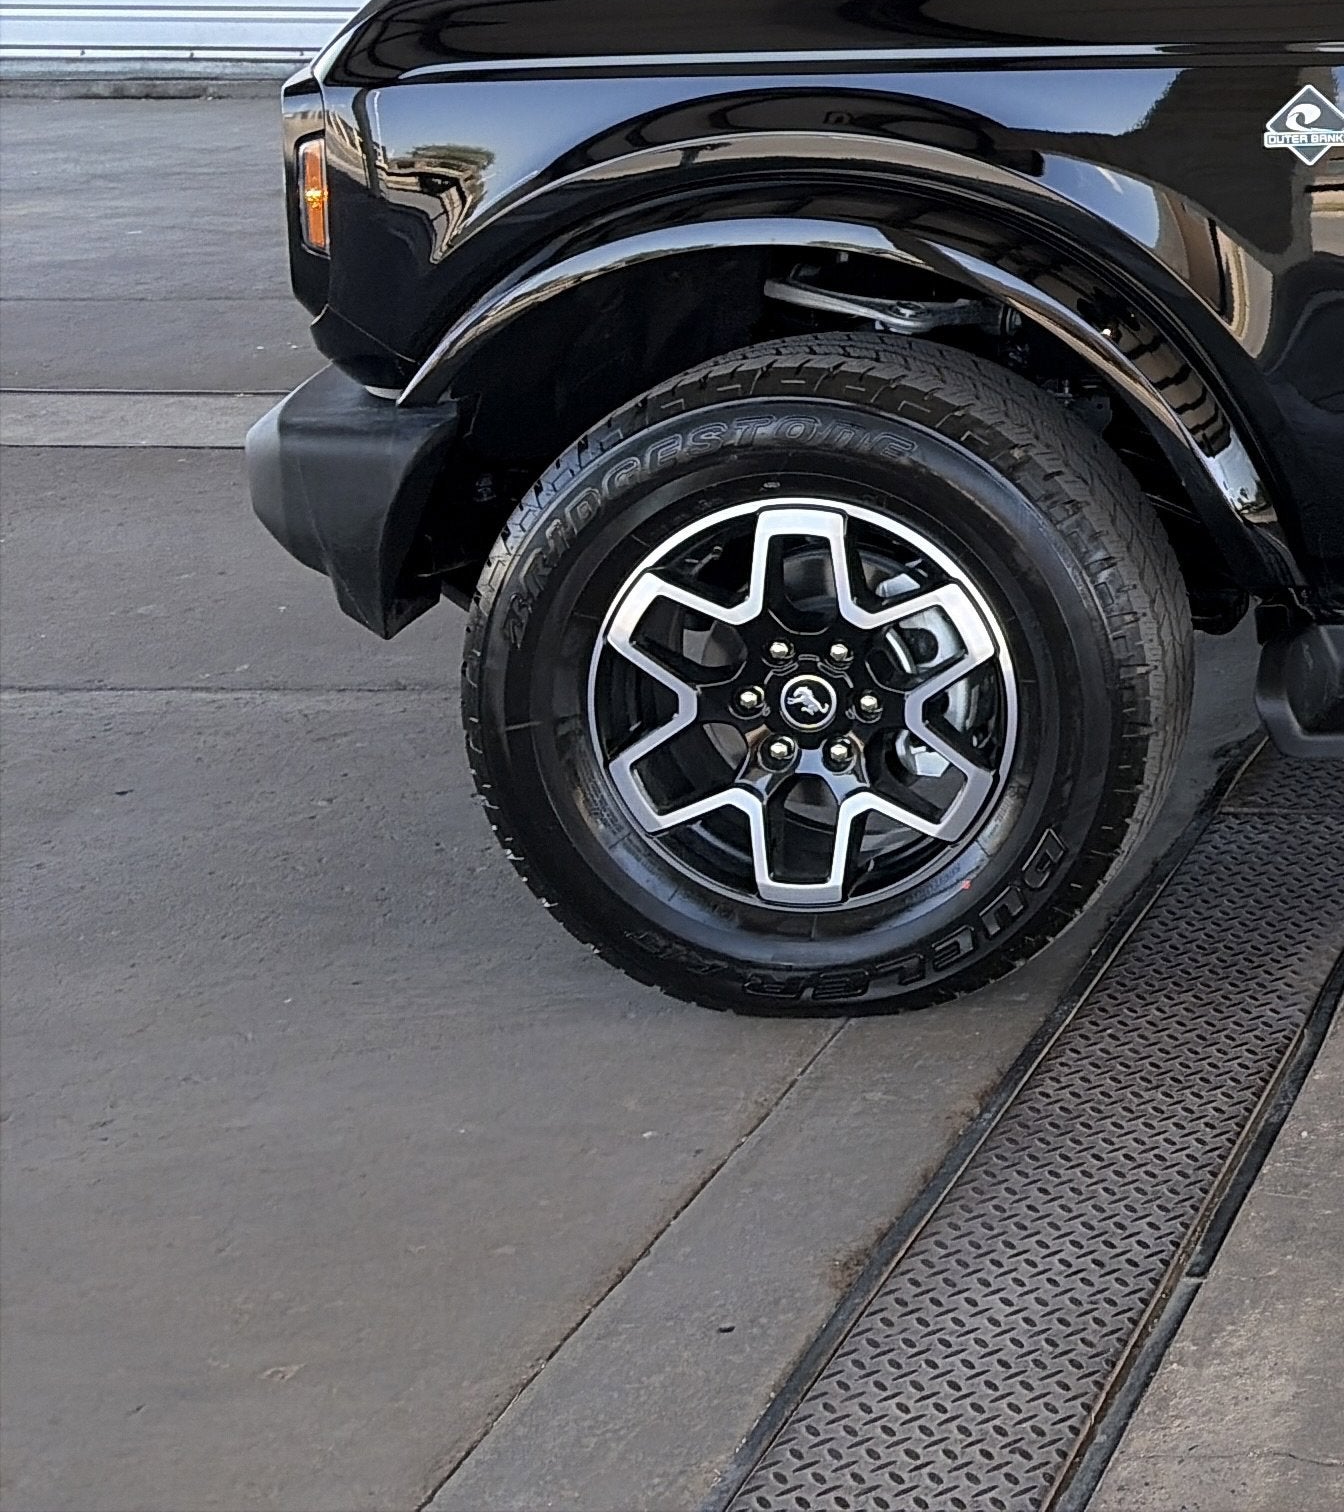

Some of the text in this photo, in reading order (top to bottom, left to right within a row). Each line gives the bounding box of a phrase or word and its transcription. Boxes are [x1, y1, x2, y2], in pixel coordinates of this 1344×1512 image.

[1268, 134, 1307, 144] OUTER
[502, 414, 919, 650] BRIDGESTONE
[741, 825, 1069, 1000] DUELER
